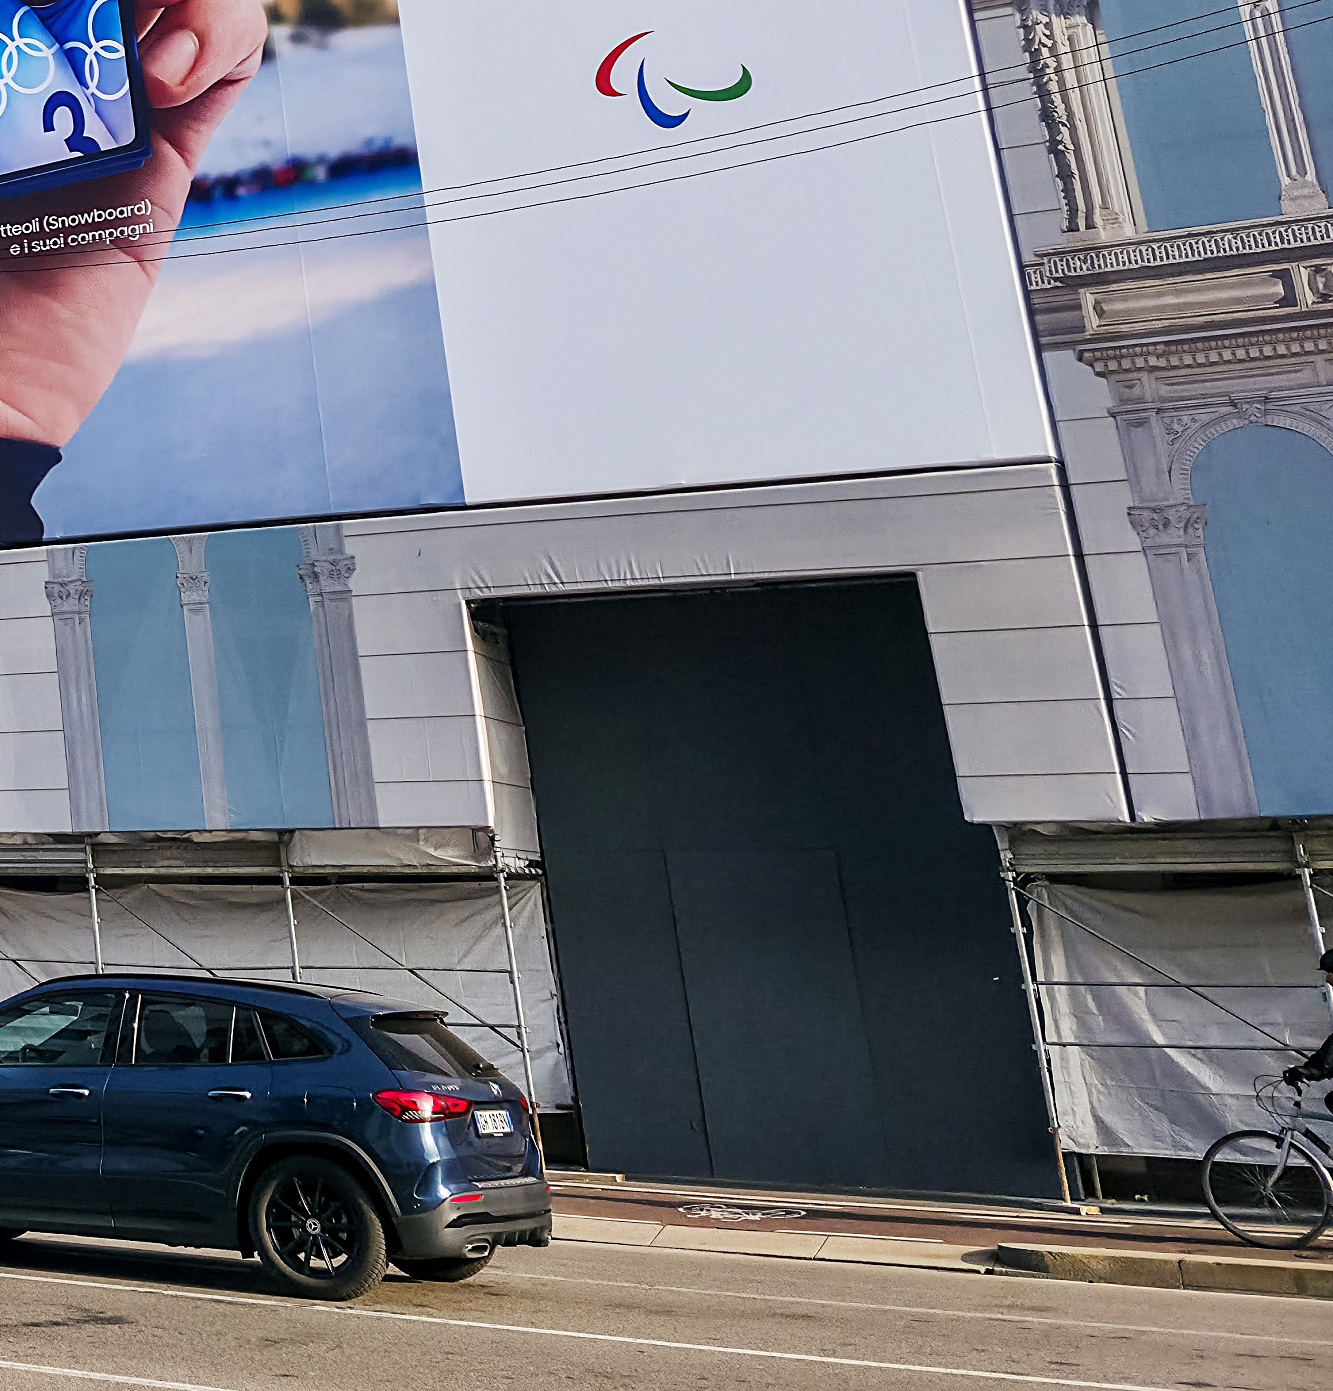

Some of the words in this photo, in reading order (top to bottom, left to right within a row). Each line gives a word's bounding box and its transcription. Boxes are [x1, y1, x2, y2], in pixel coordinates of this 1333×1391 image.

[43, 198, 152, 232] (Snowboard)
[9, 243, 21, 256] e
[31, 233, 65, 253] suoi
[68, 218, 154, 246] compagni
